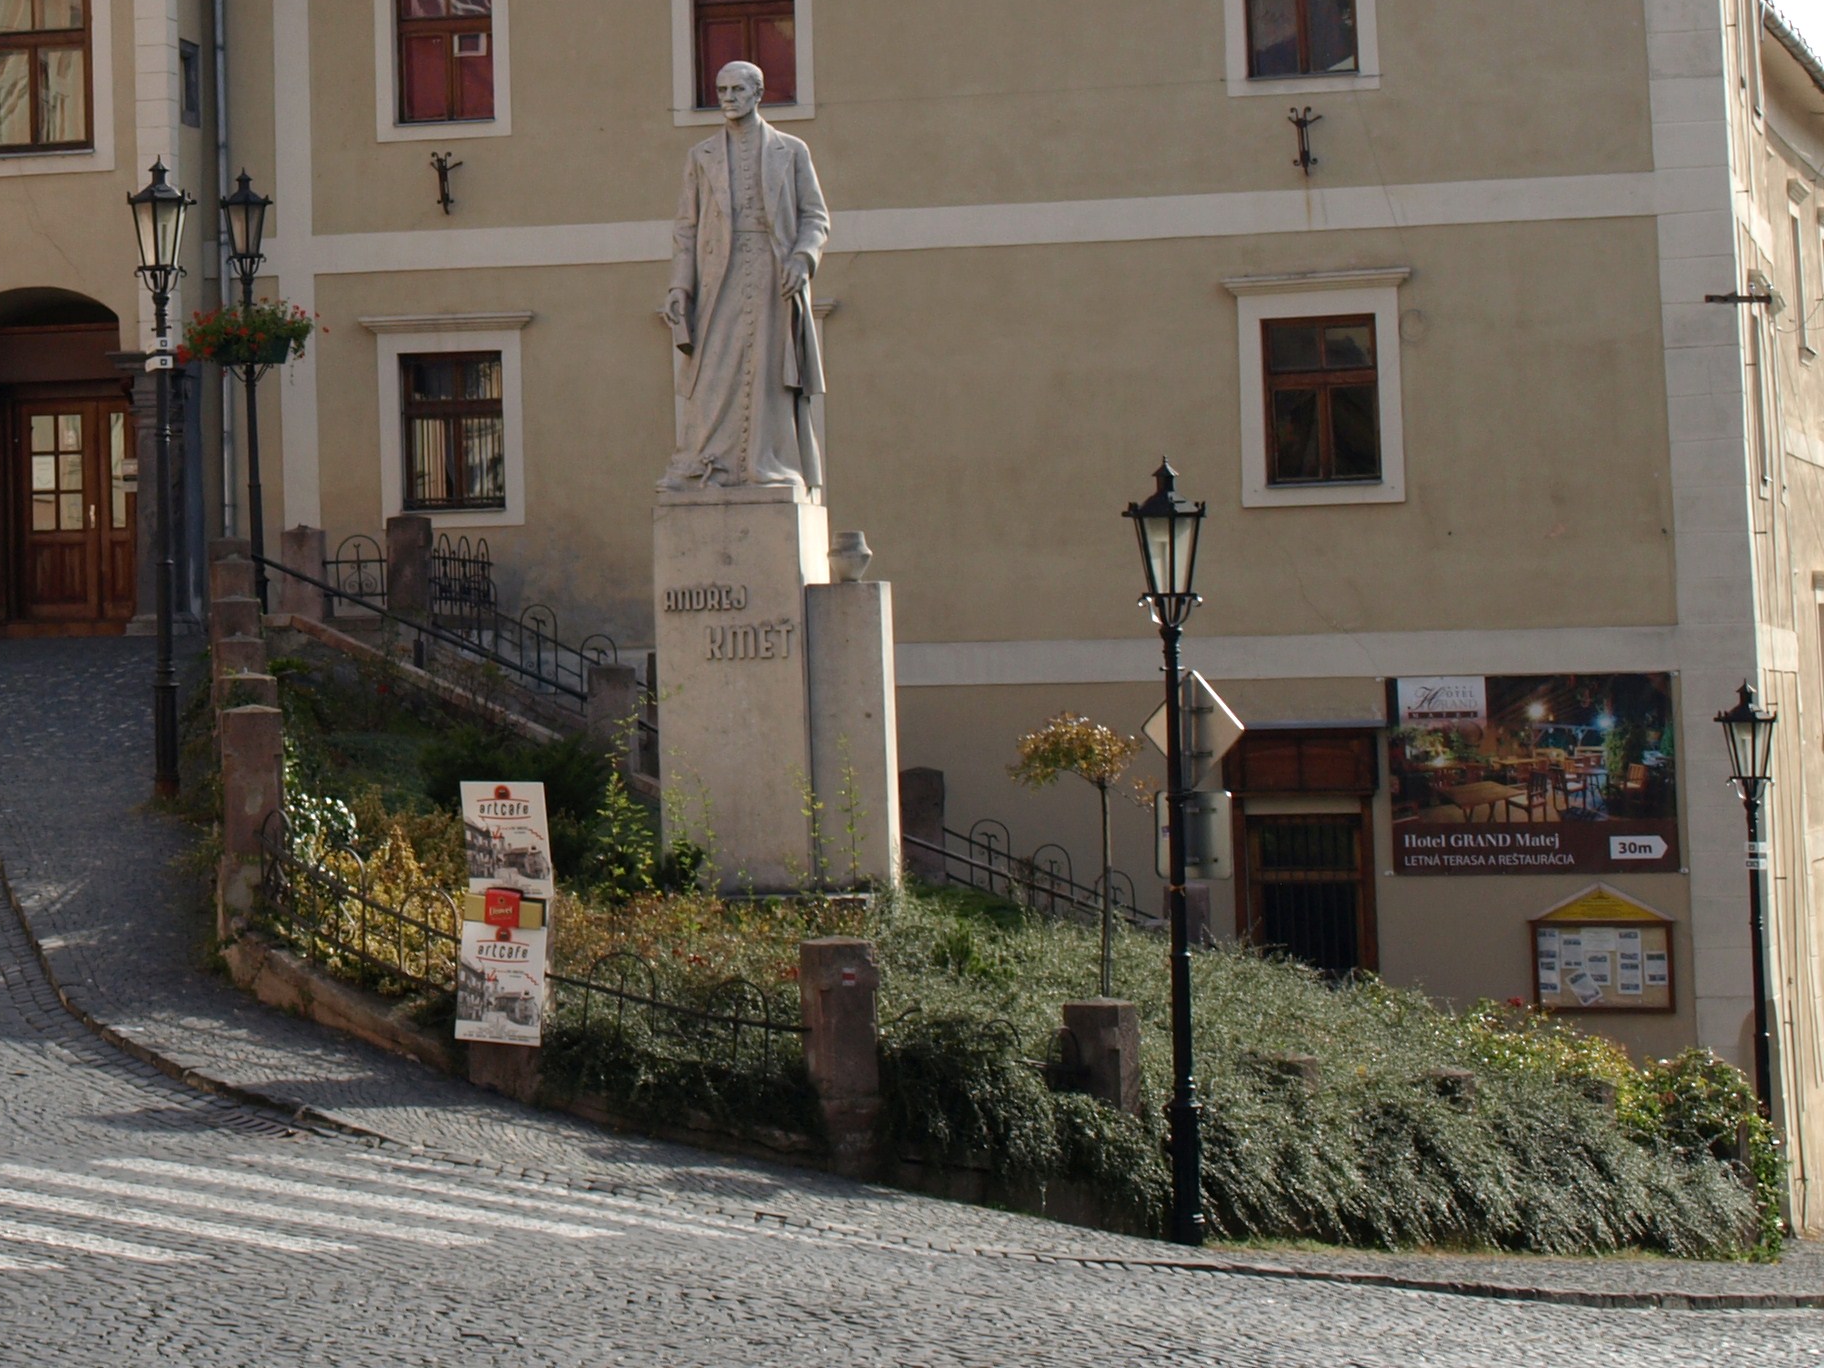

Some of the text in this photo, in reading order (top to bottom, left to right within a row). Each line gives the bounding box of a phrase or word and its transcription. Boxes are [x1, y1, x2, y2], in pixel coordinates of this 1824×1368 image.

[664, 584, 747, 612] ANDREJ
[1404, 833, 1560, 849] Hotel GRAND Matej
[1618, 842, 1653, 854] 30m
[1404, 852, 1575, 866] LETNÁ TERASA A REŠTAURÁCIA
